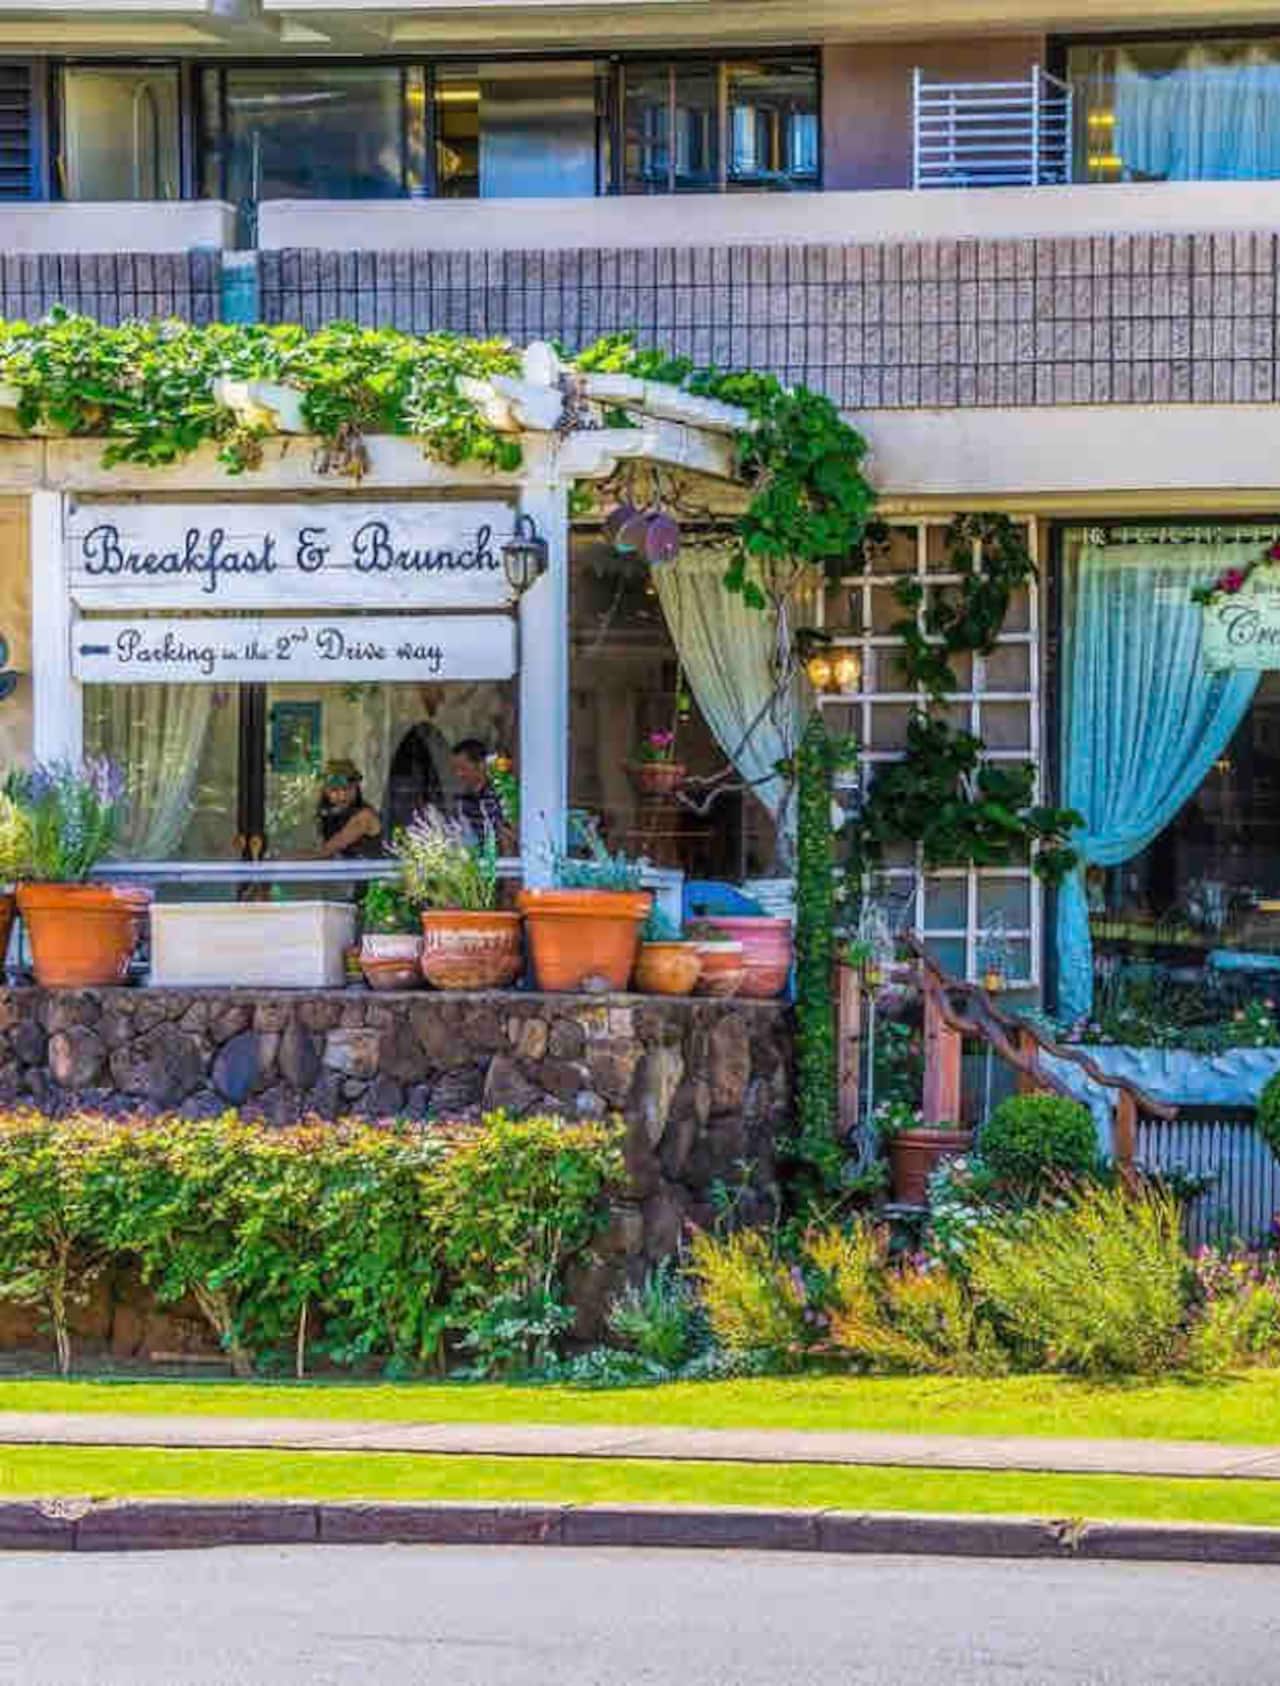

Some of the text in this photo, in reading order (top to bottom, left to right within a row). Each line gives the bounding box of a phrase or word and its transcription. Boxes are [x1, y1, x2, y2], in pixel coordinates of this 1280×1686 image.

[82, 521, 500, 593] Breakfast & Brunch
[117, 628, 215, 675] Parking
[245, 639, 271, 660] the
[316, 627, 385, 660] Drive
[396, 642, 444, 673] way
